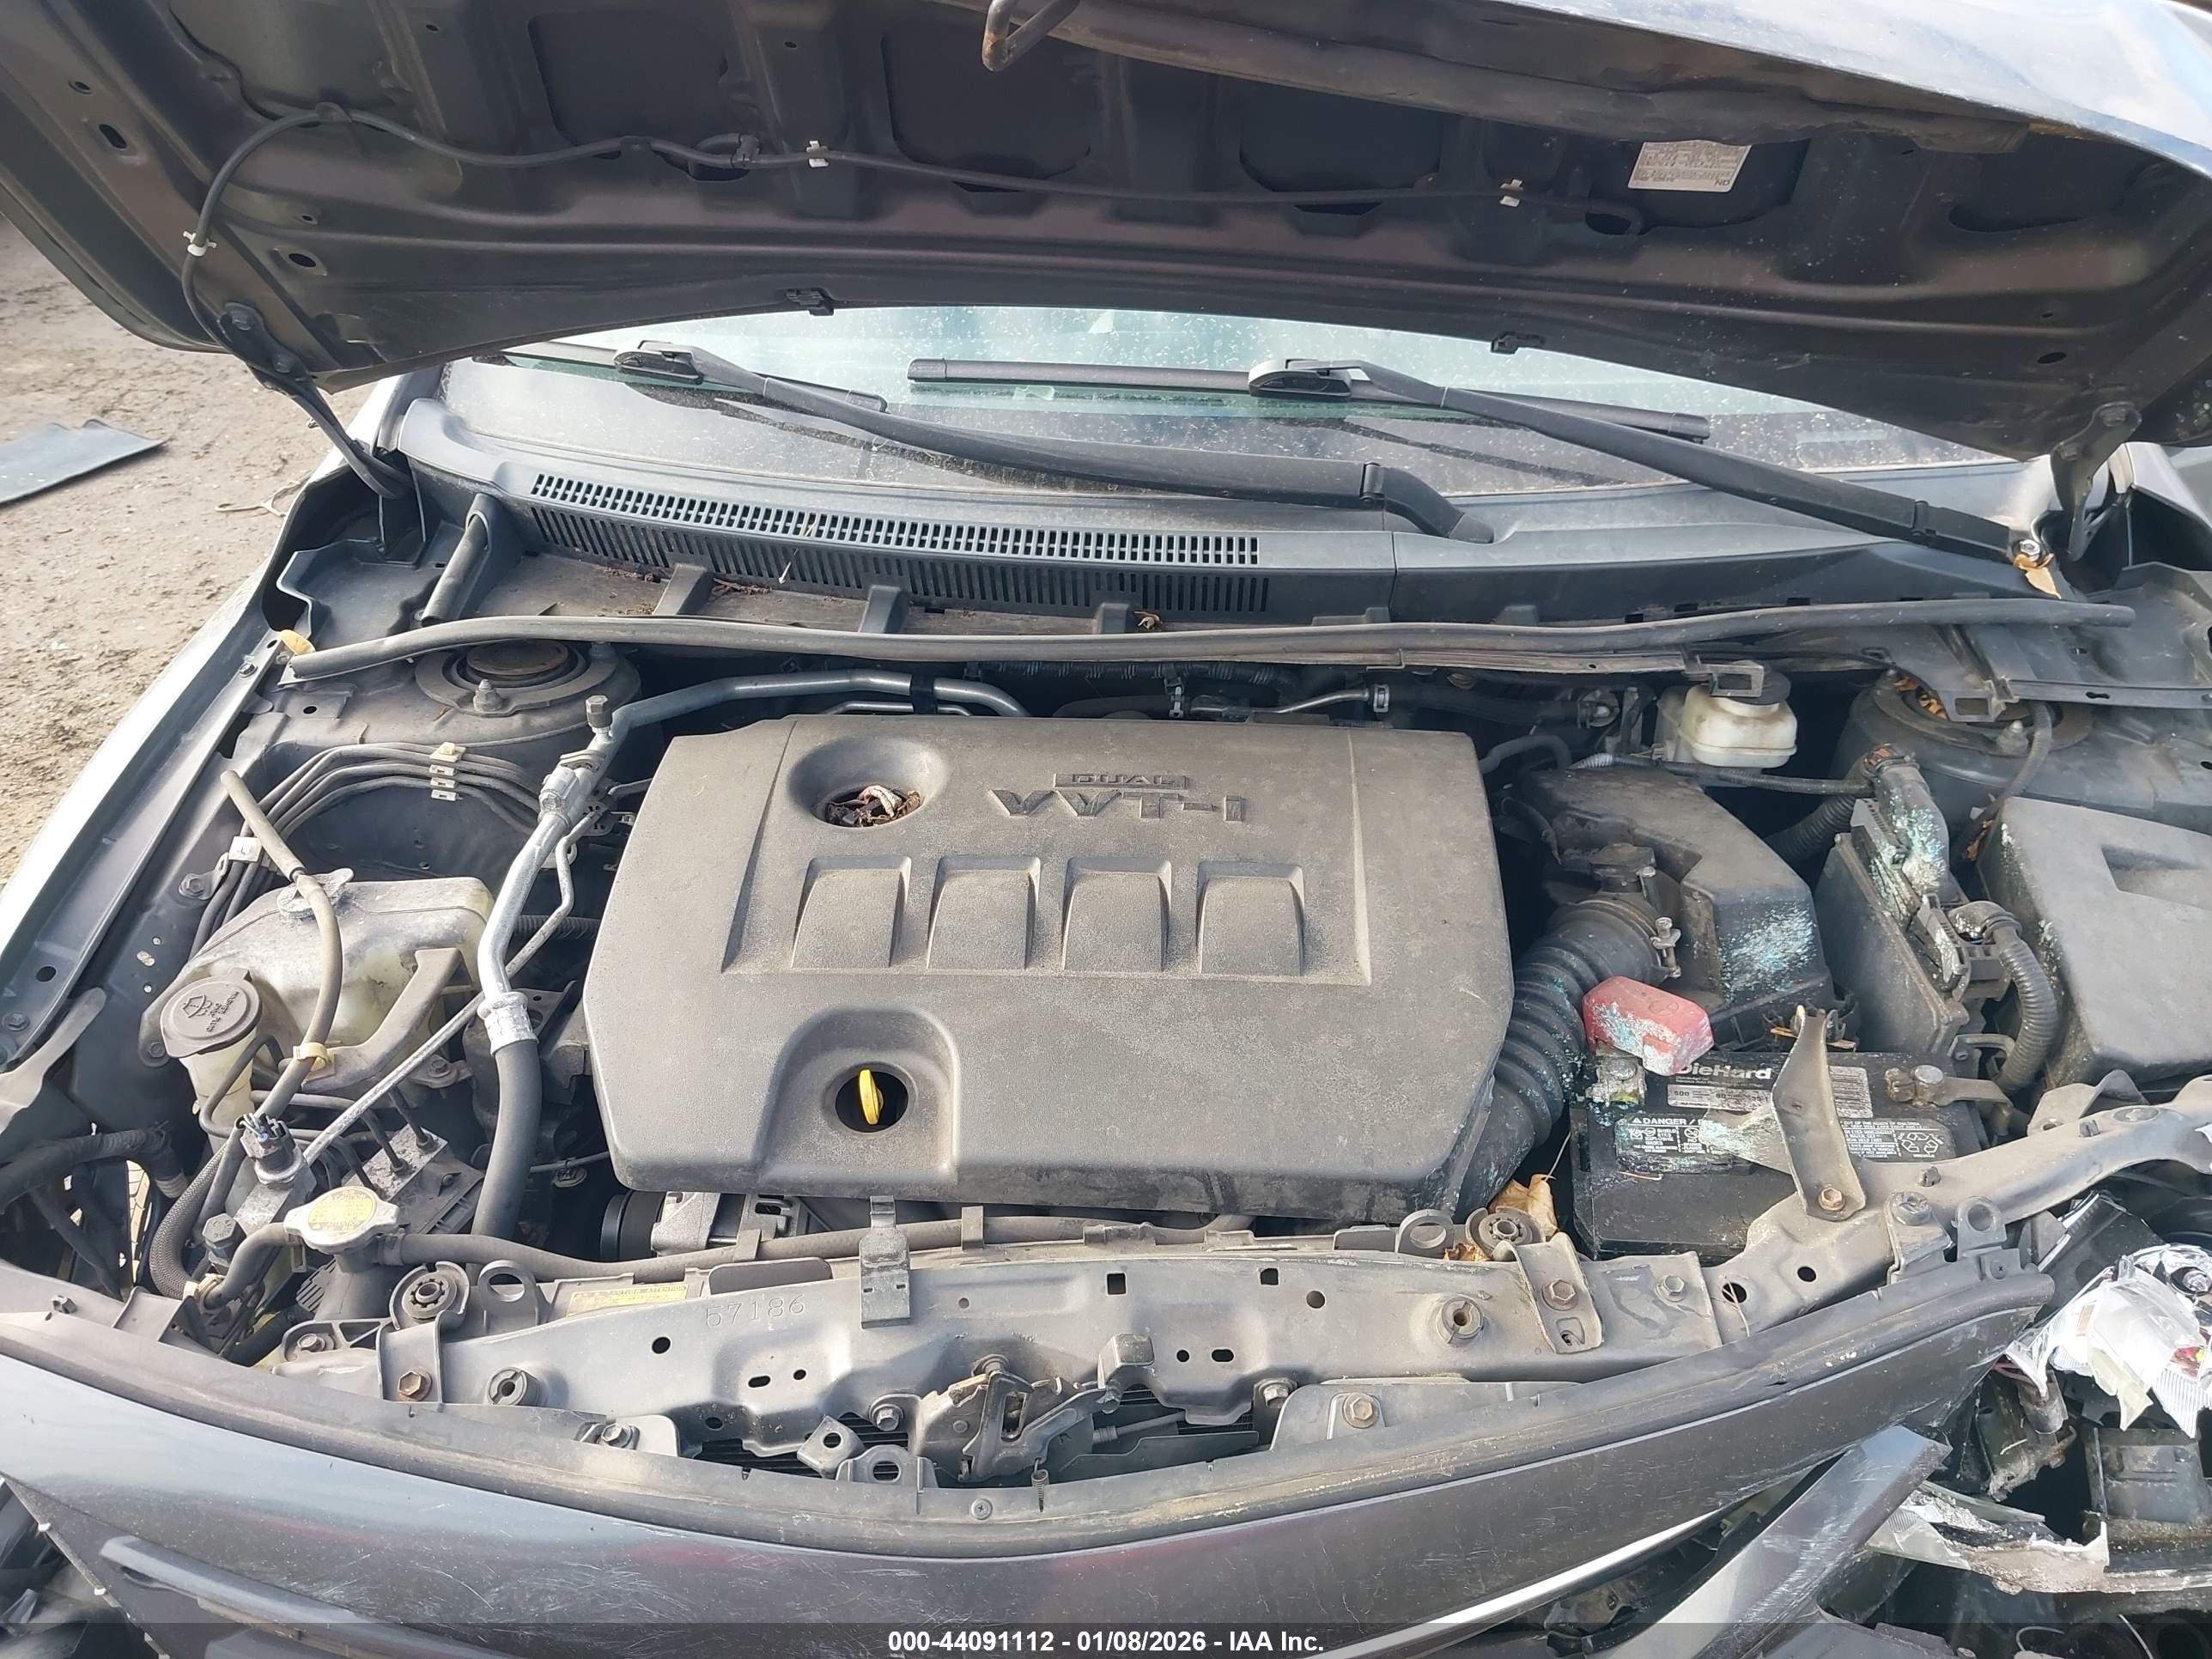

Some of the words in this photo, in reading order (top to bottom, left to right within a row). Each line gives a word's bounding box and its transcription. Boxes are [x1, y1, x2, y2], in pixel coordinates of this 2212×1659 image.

[1073, 773, 1177, 785] DUAL
[1643, 1117, 1687, 1126] DANGER
[705, 1295, 805, 1328] 57186
